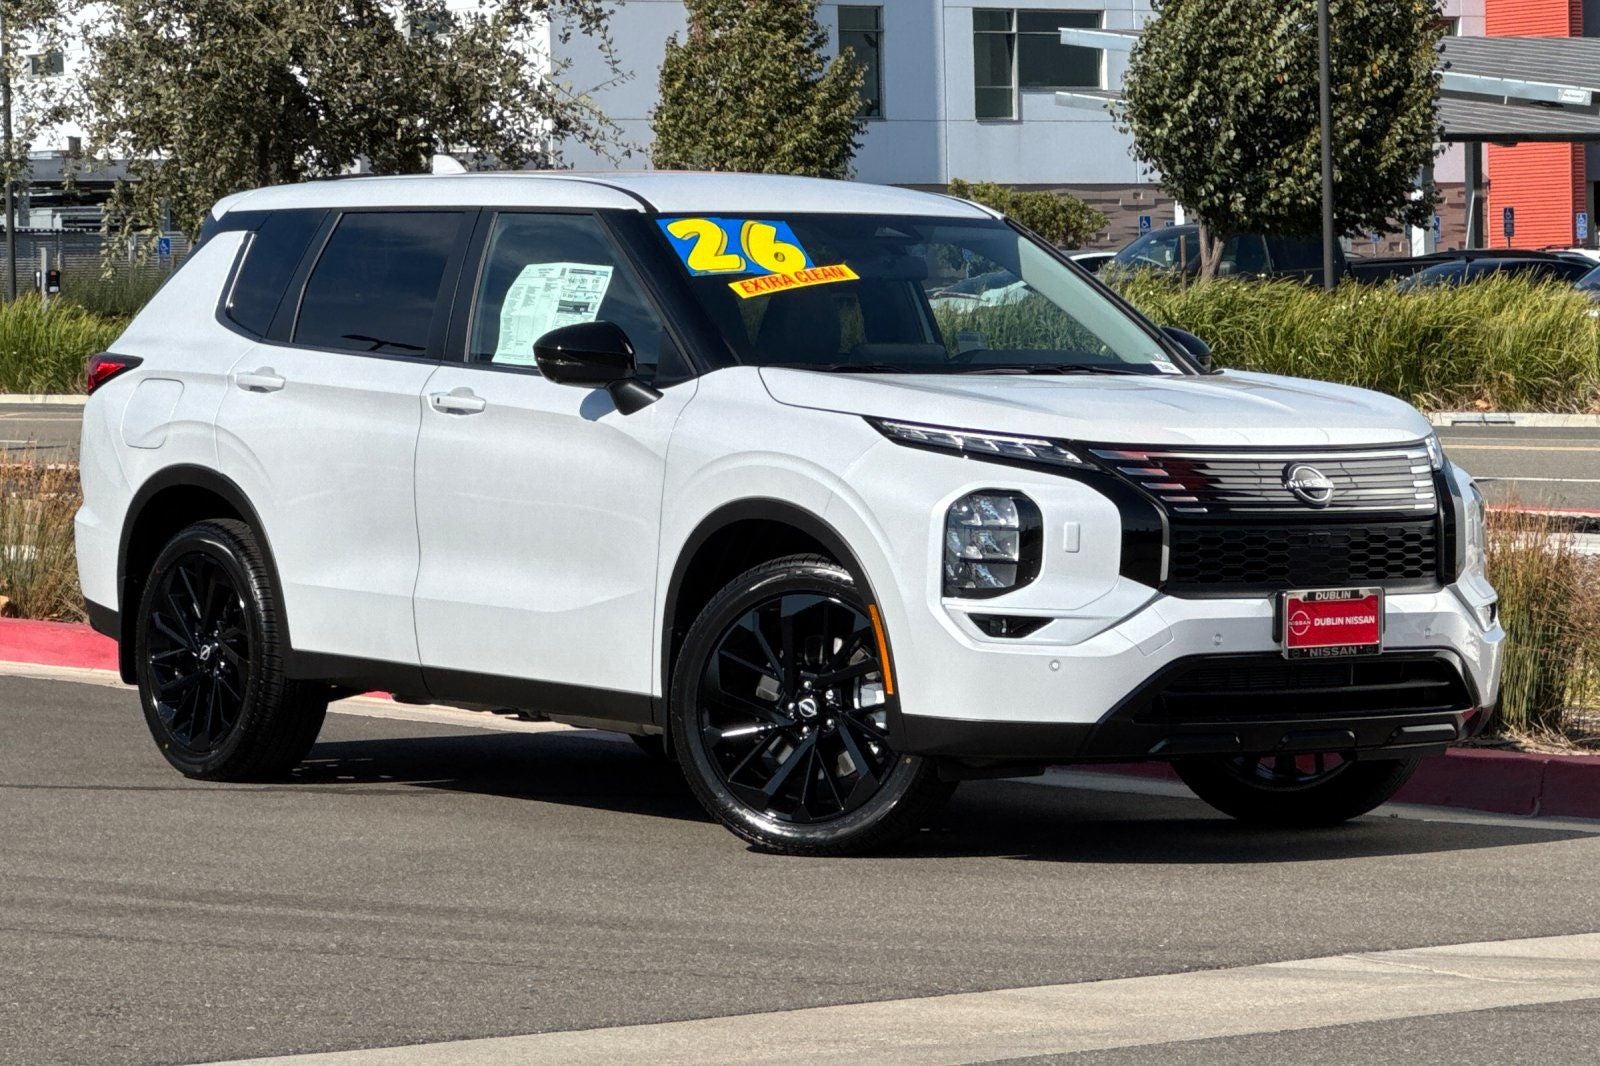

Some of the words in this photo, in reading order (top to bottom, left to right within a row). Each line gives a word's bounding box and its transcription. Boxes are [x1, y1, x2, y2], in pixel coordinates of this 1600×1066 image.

[666, 217, 807, 274] 26
[740, 273, 794, 294] EXTRA
[794, 266, 847, 284] CLEAN
[1315, 590, 1352, 600] DUBLIN
[1314, 617, 1344, 627] DUBLIN
[1345, 615, 1375, 625] NISSAN
[1309, 646, 1358, 657] NISSAN
